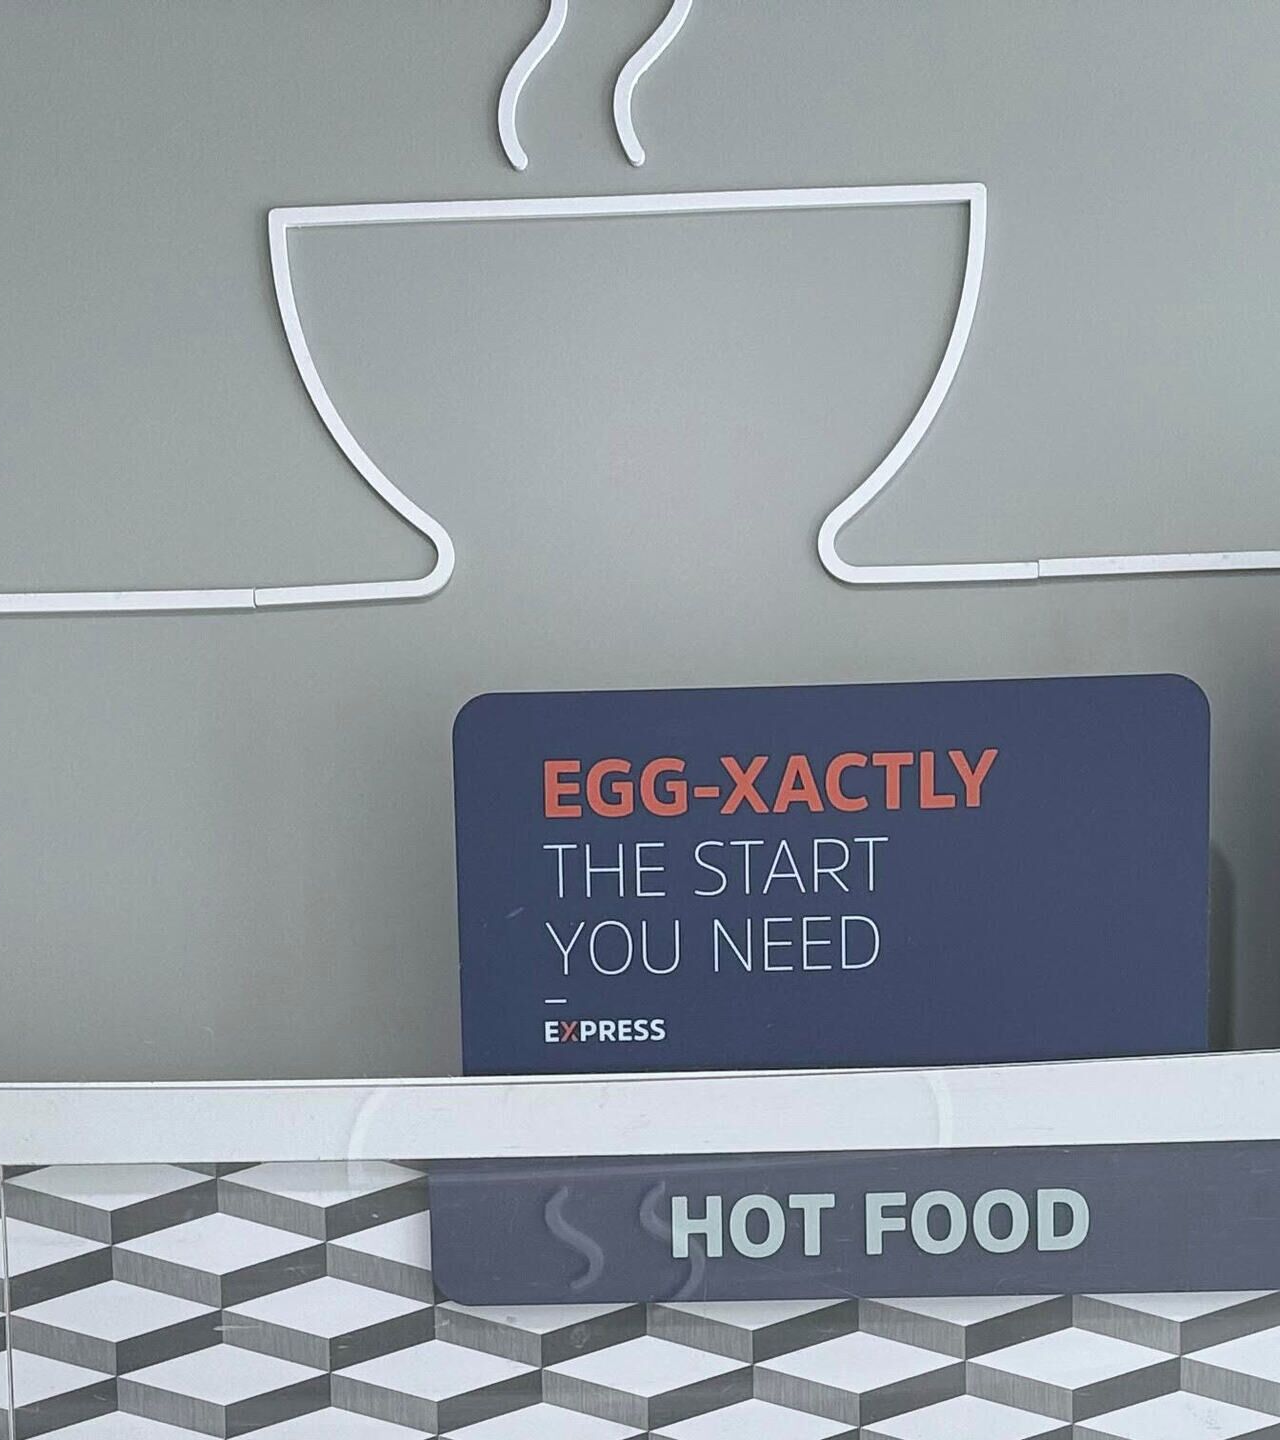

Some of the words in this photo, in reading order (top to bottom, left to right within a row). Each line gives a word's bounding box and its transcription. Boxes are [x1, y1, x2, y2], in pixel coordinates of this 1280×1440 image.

[543, 748, 999, 818] EGG-XACTLY
[543, 842, 666, 898] THE
[693, 836, 889, 896] START
[545, 919, 681, 976] YOU
[712, 915, 881, 973] NEED
[544, 1018, 666, 1043] EXPRESS
[670, 1192, 835, 1259] HOT
[865, 1188, 1090, 1255] FOOD
